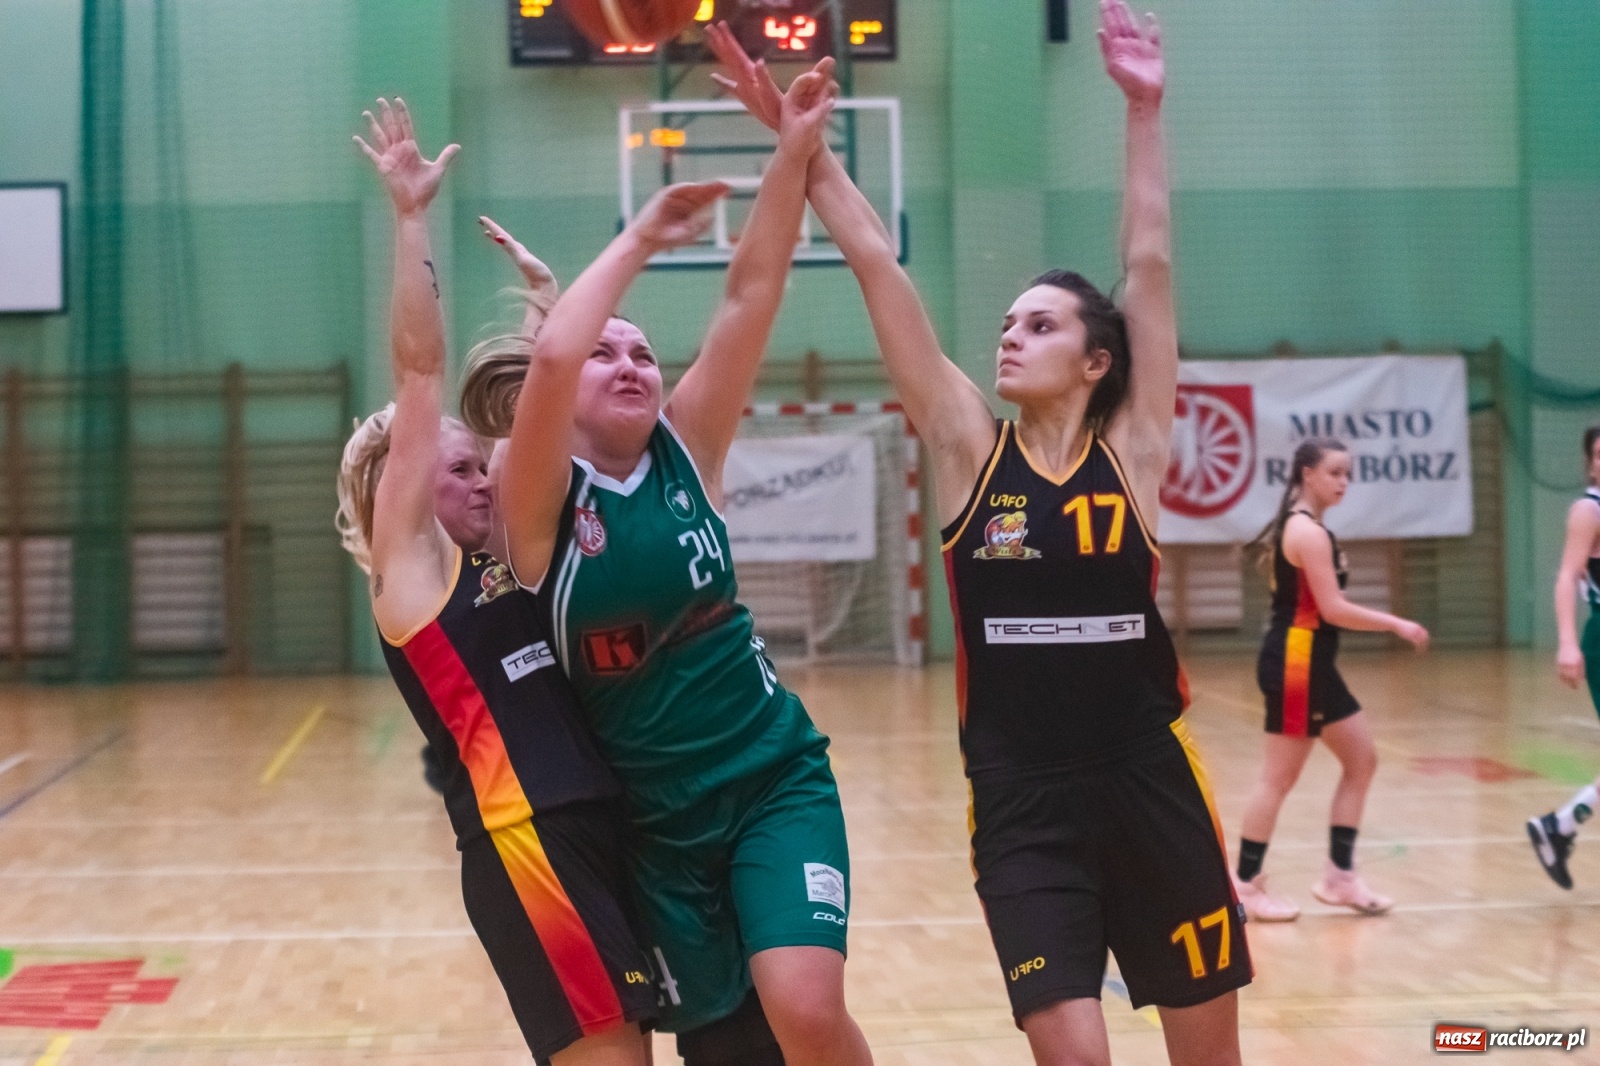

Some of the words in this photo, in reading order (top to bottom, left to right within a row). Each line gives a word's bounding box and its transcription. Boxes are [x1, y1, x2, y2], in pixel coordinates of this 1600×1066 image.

[764, 15, 816, 50] 42
[1290, 410, 1432, 440] MIASTO
[1265, 444, 1458, 485] RBÓRZ
[1063, 493, 1126, 554] 17
[678, 518, 725, 590] 24
[988, 620, 1141, 635] TECHNET
[507, 646, 553, 669] TEC
[1171, 906, 1231, 978] 17
